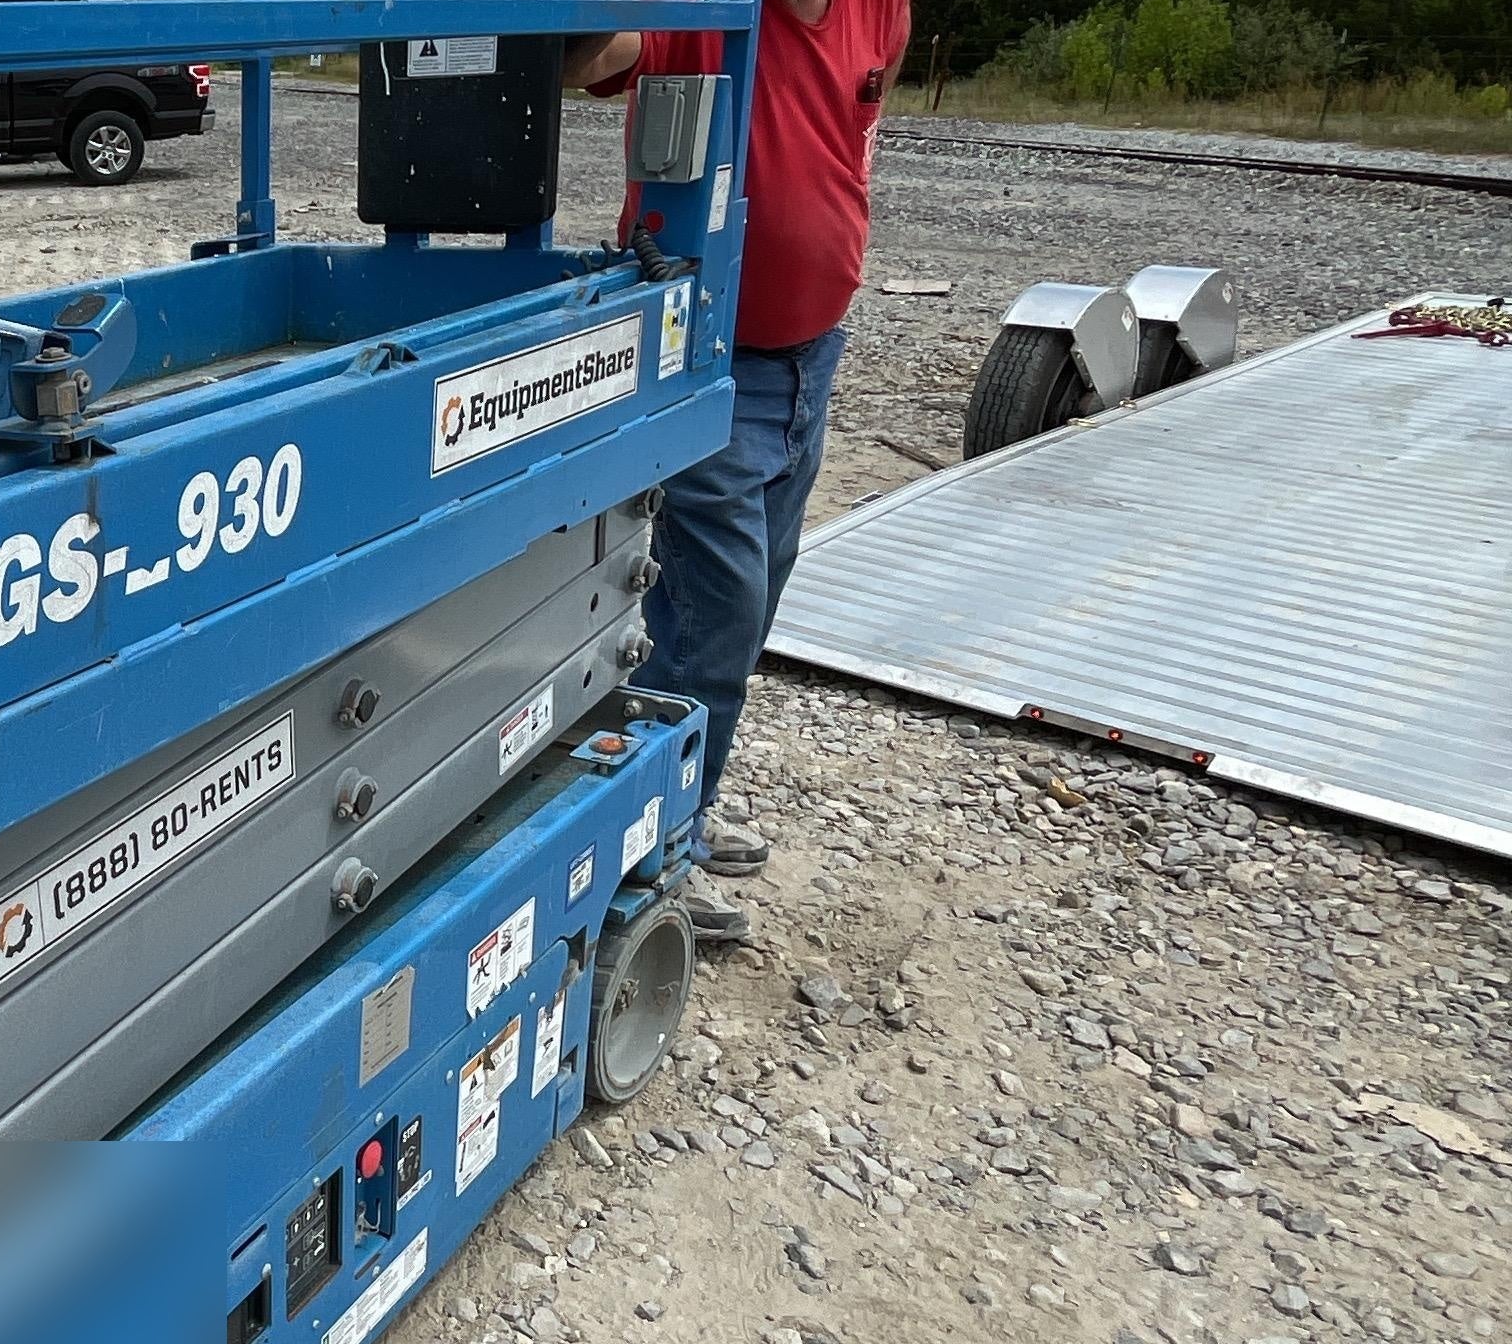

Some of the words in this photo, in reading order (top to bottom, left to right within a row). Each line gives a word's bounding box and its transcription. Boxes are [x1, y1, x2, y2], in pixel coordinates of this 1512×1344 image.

[469, 346, 634, 431] EquipmentShare
[53, 832, 140, 919] (888)
[151, 739, 282, 851] 80-RENTS
